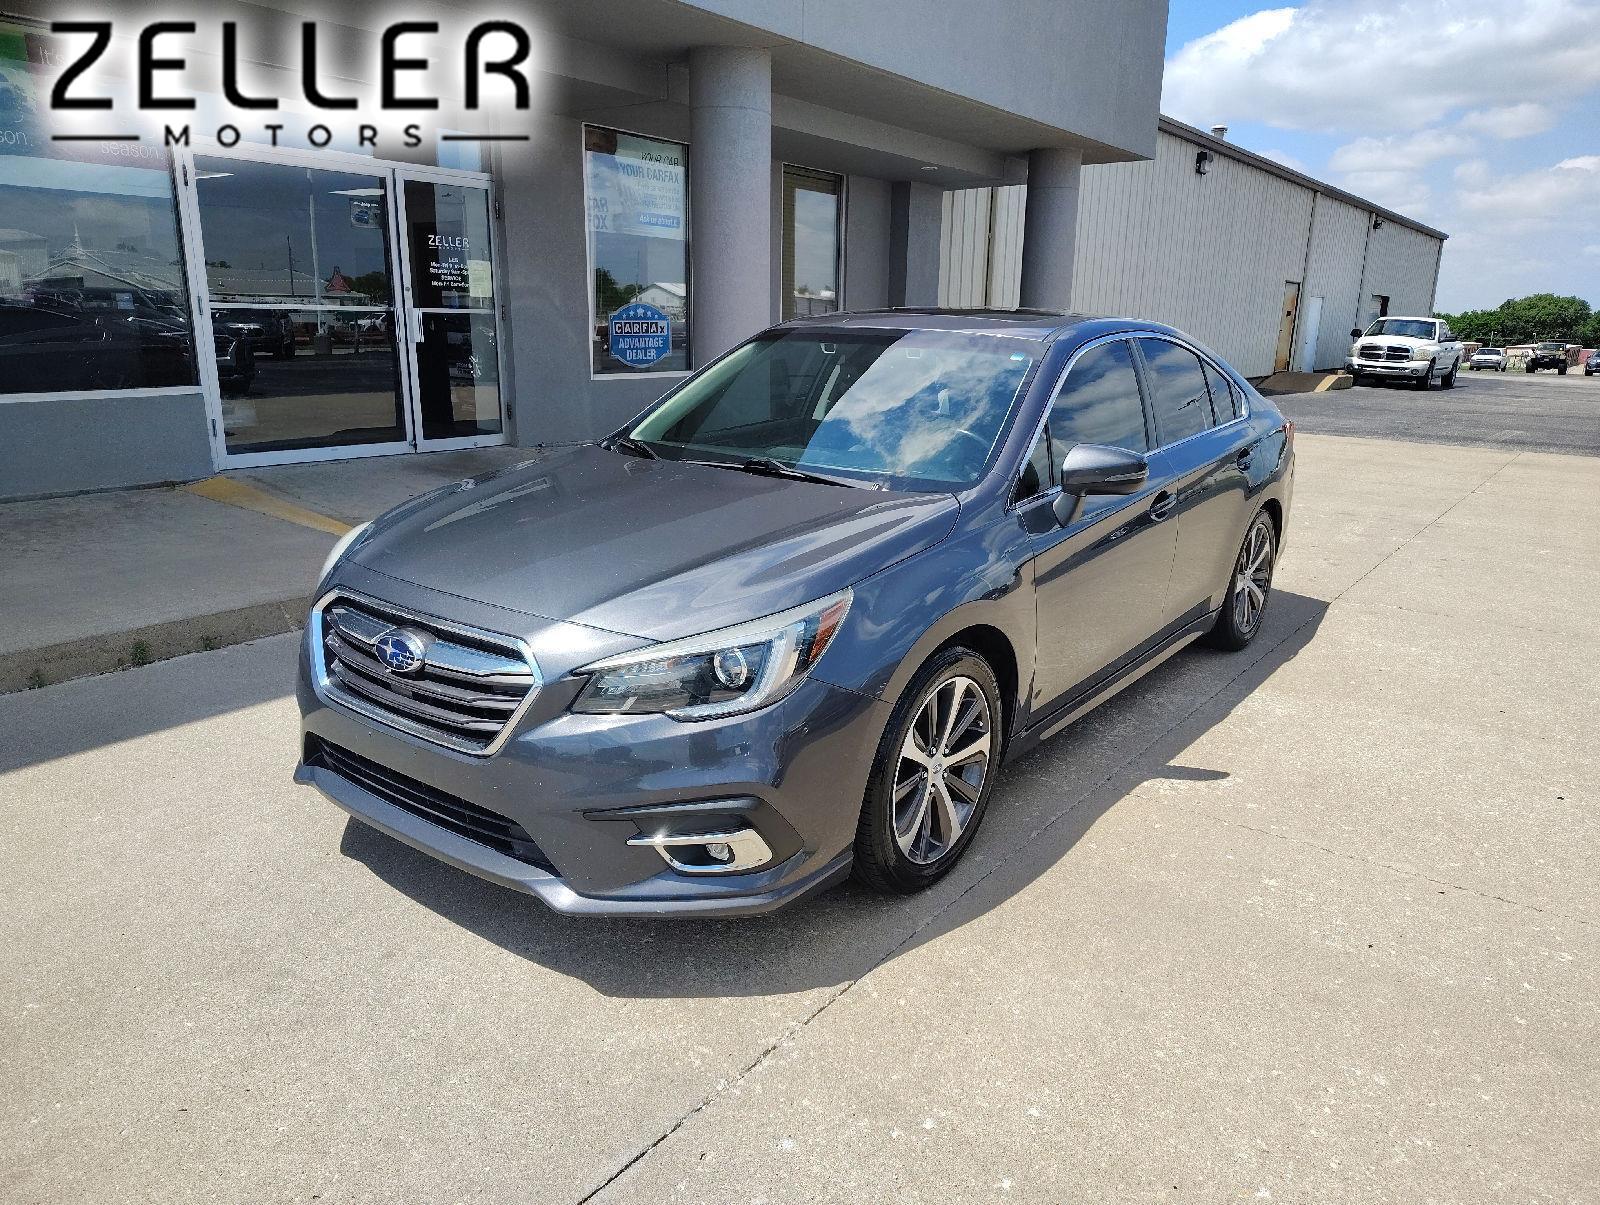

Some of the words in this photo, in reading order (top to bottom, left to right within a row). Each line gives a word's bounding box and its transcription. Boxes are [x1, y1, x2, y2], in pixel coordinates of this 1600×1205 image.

[619, 163, 645, 179] YOUR
[646, 168, 680, 185] CARFAX
[428, 235, 469, 248] ZELLER
[614, 321, 667, 335] CARFAX
[618, 337, 664, 349] ADVANTAGE
[627, 349, 656, 360] DEALER
